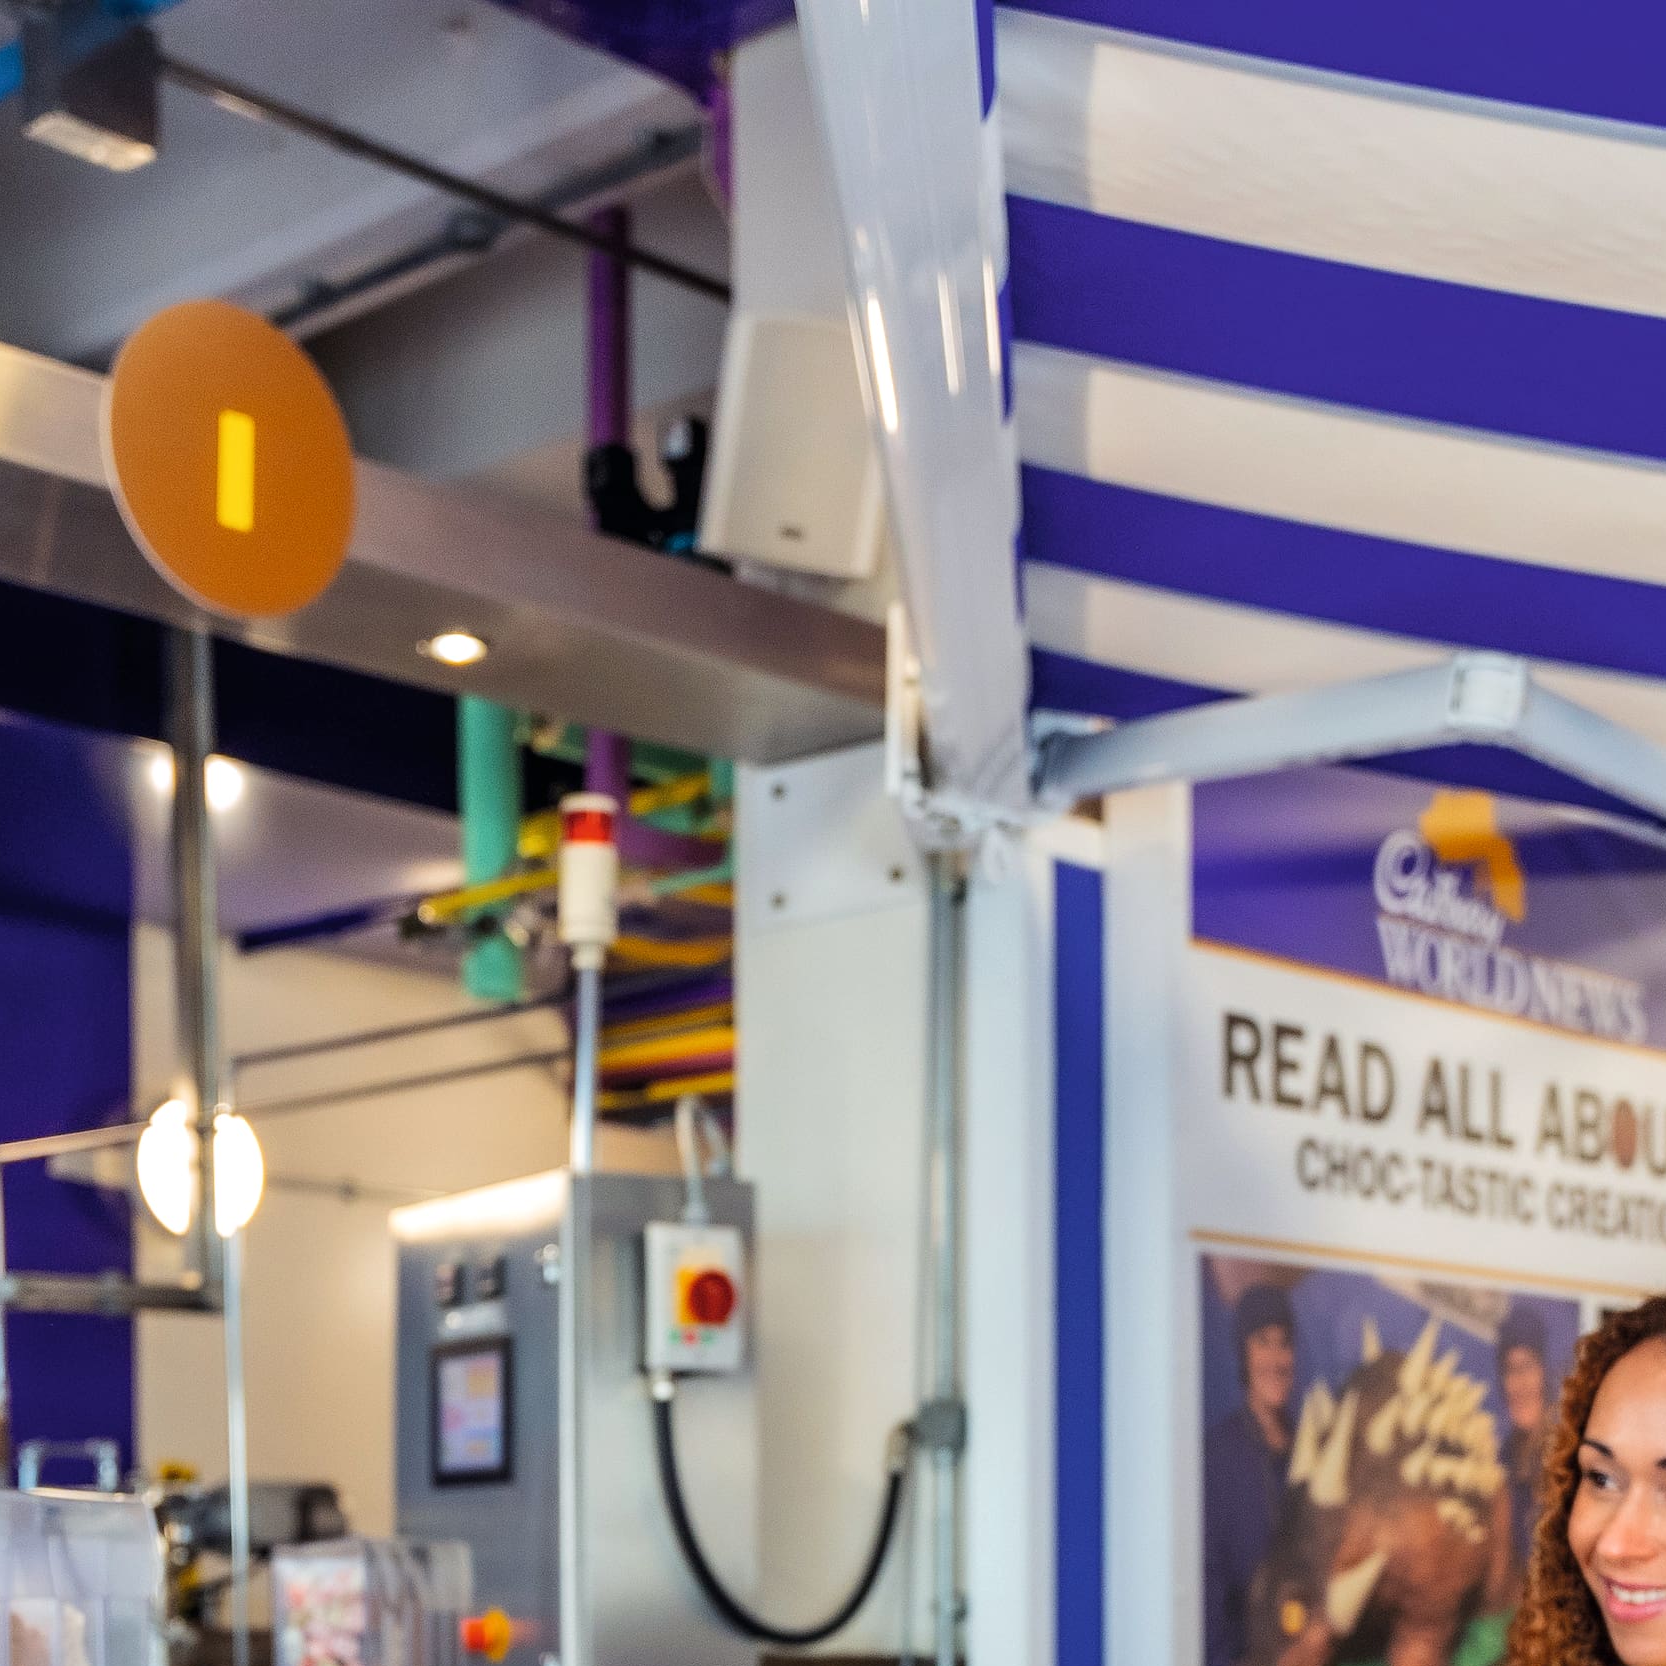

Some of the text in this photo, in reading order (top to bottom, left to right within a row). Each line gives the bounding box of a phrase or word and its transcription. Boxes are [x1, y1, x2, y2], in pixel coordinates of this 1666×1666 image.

[1221, 1011, 1395, 1125] READ
[1415, 1053, 1517, 1148] ALL
[1296, 1135, 1535, 1226] CHOC-TASTIC
